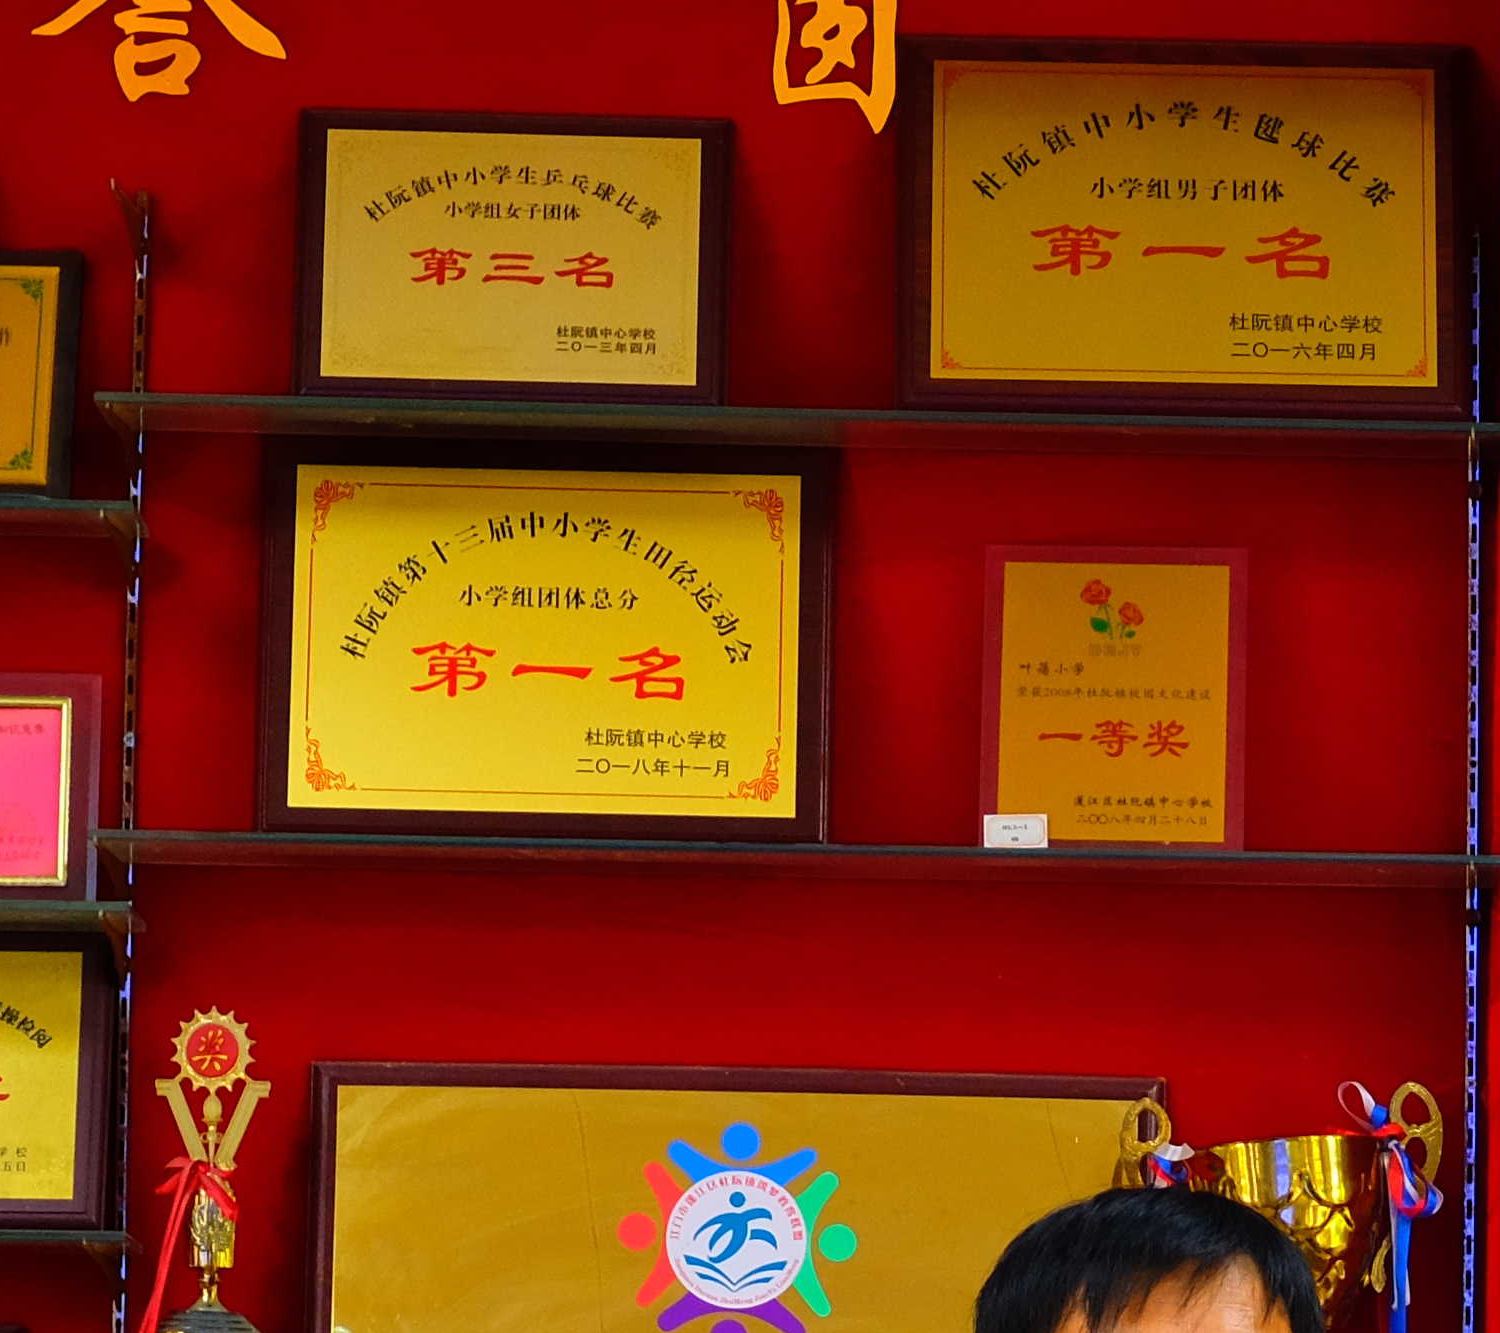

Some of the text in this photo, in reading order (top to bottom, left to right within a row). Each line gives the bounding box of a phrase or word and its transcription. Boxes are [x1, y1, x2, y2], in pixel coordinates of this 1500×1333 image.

[971, 101, 1396, 208] 杜阮镇中小学生毽球比赛
[363, 164, 662, 231] 杜阮镇中小学生乒乓球比赛
[1090, 176, 1285, 203] 小学组男子团体
[444, 200, 581, 222] 小学组女子团体
[409, 247, 614, 289] 第三名
[1030, 223, 1331, 280] 第一名
[556, 325, 657, 341] 杜阮镇中心学校
[1228, 312, 1383, 335] 杜阮镇中心学校
[340, 510, 754, 666] 杜阮镇第十三届中小学生田径运动会
[459, 584, 640, 612] 小学组团体总分
[409, 641, 685, 701] 第一名
[584, 728, 727, 751] 杜阮镇中心学校
[1037, 719, 1189, 758] 一等奖
[190, 1029, 228, 1071] 奖
